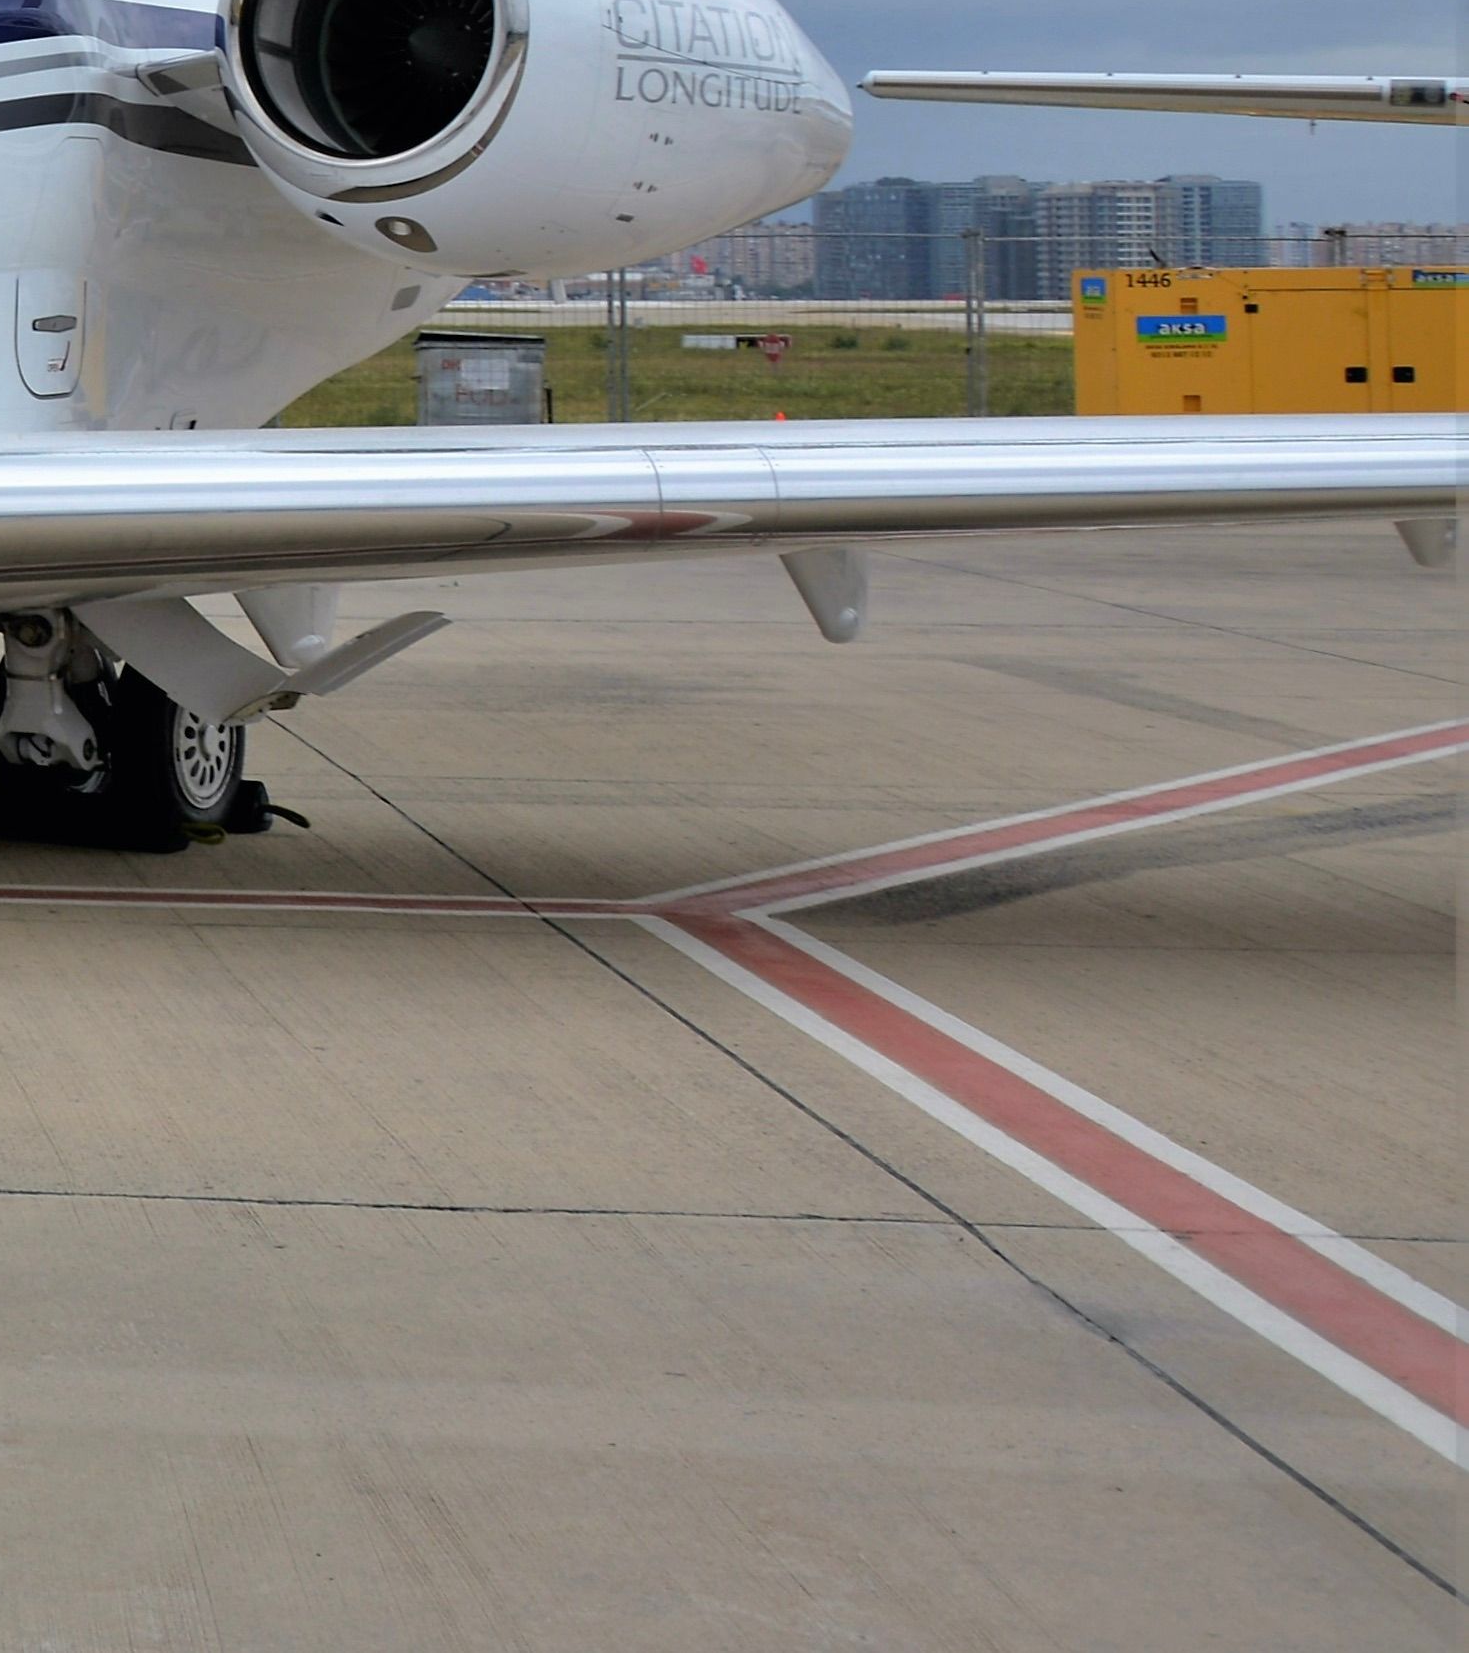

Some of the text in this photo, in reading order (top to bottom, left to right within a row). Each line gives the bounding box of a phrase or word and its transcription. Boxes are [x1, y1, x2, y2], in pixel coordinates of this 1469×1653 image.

[615, 66, 802, 115] LONGITUDE
[1125, 273, 1172, 288] 1446
[1158, 321, 1206, 335] aksa
